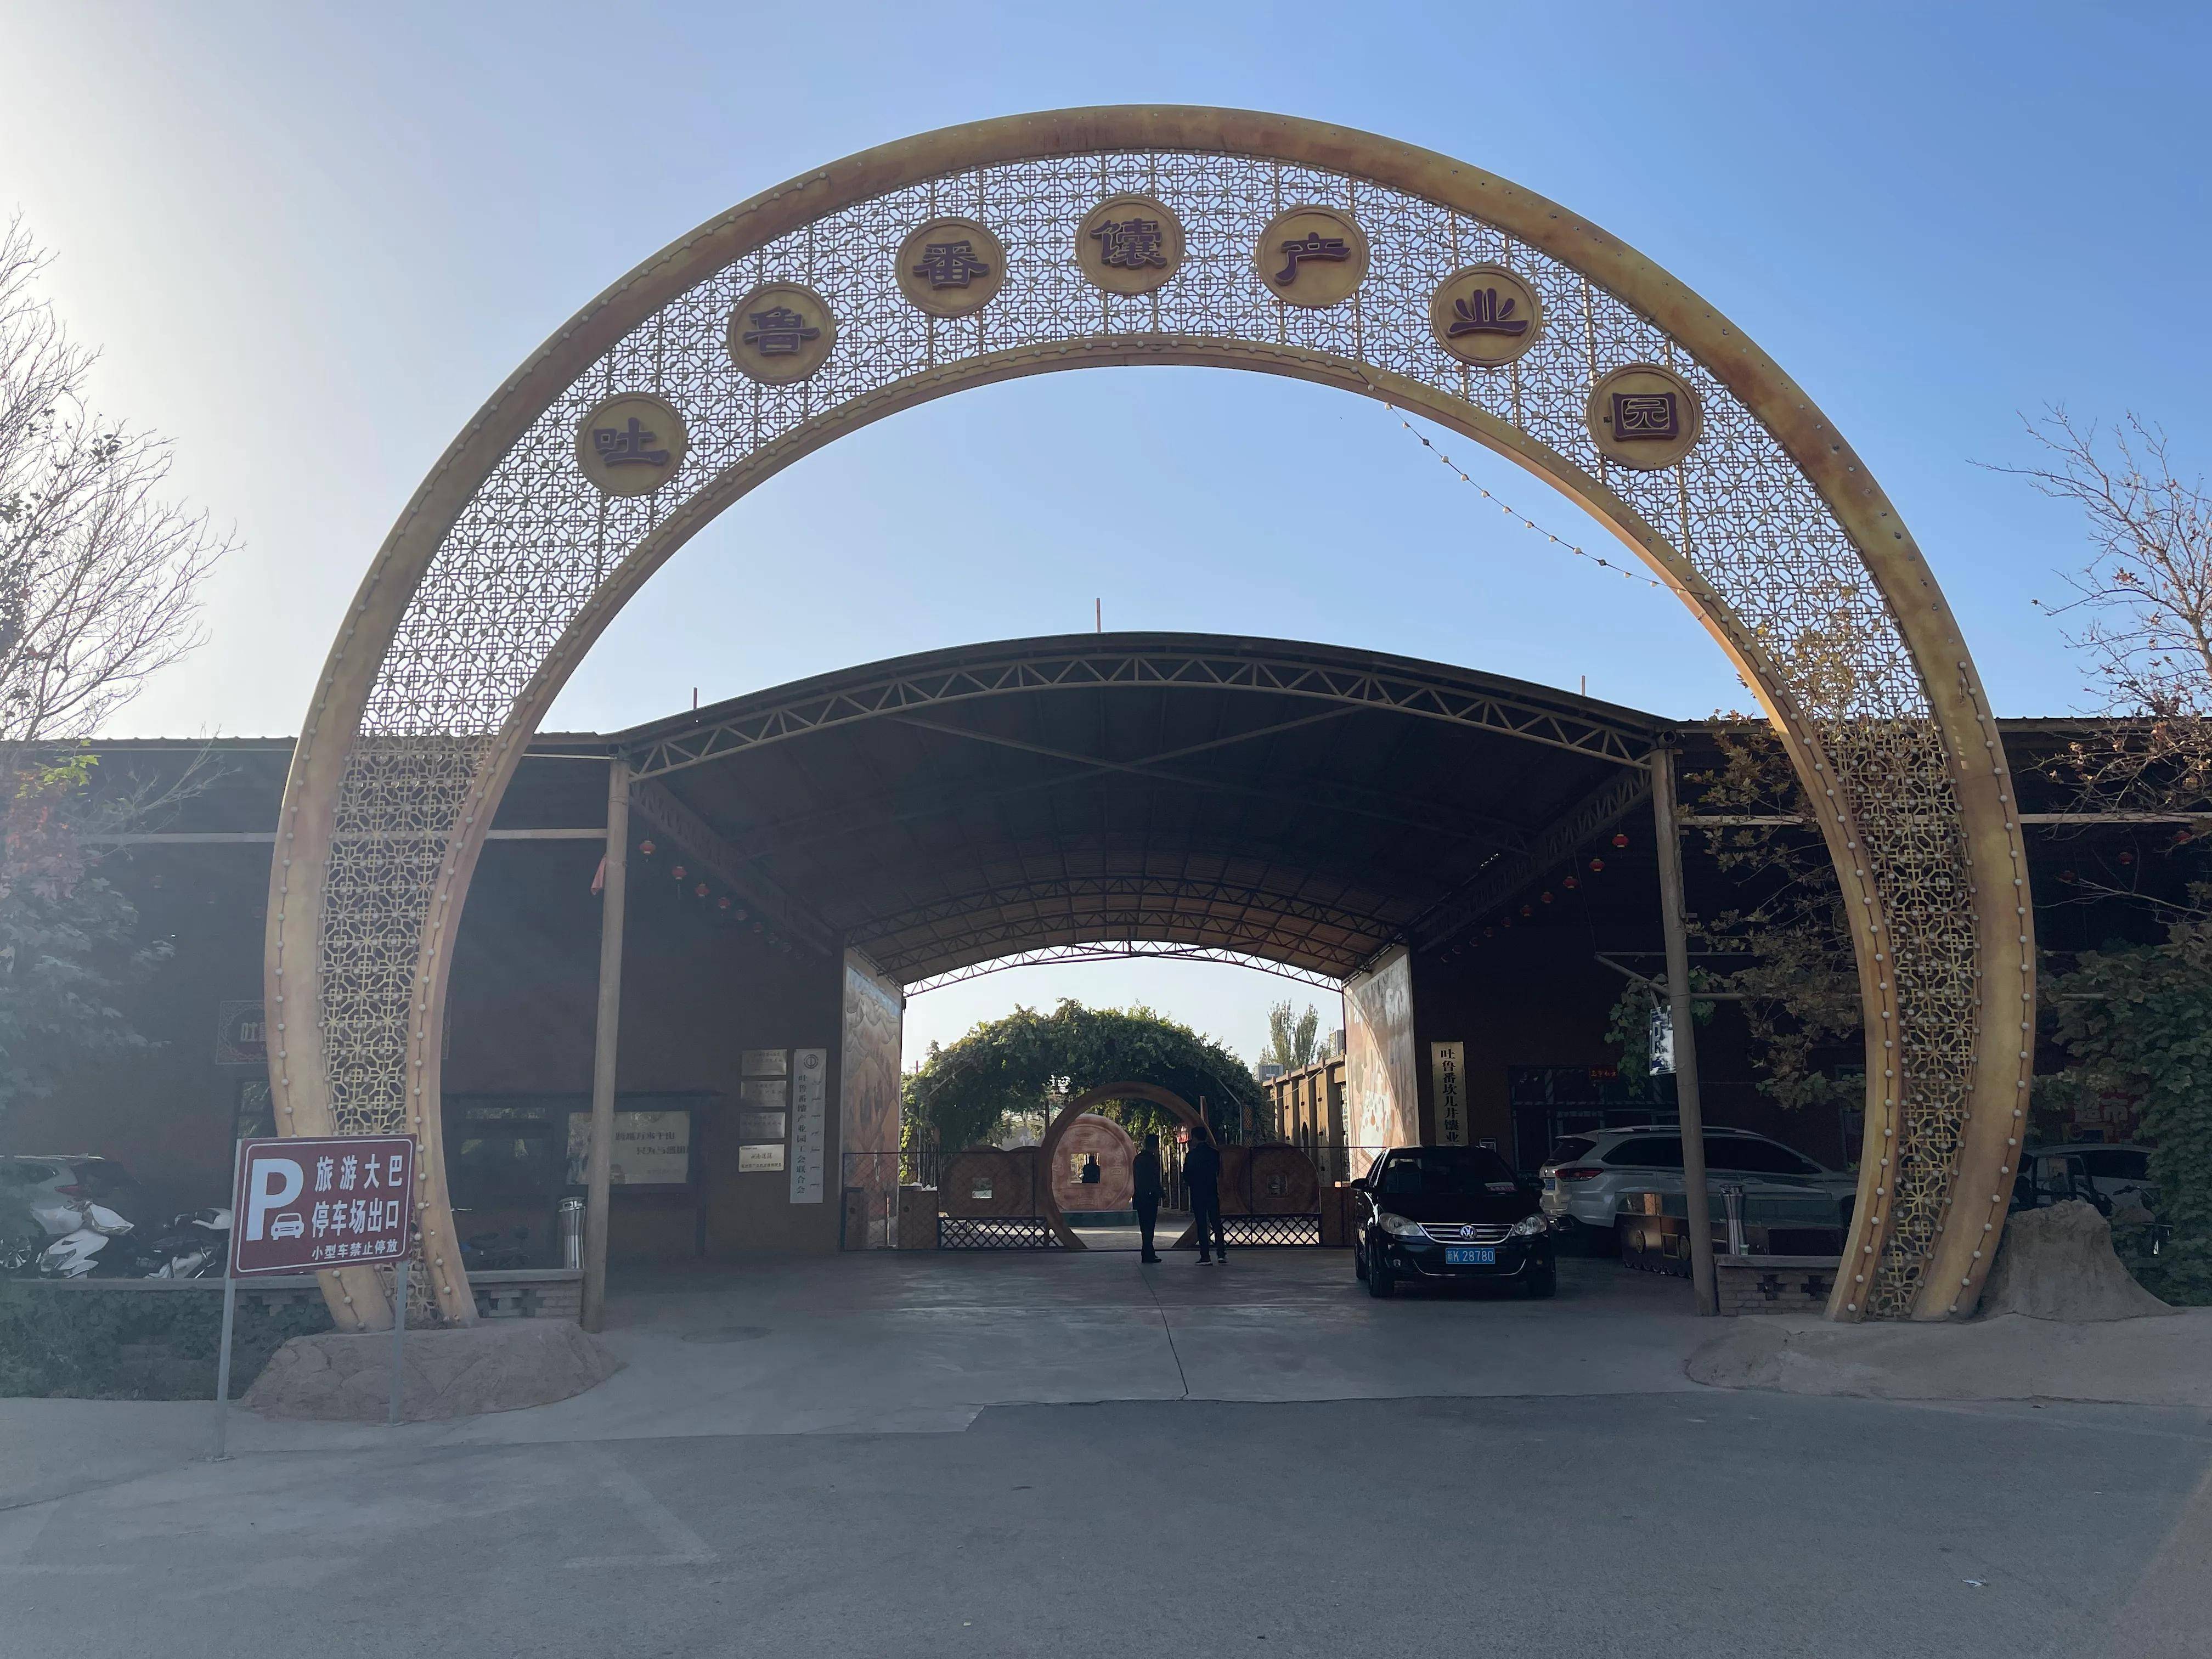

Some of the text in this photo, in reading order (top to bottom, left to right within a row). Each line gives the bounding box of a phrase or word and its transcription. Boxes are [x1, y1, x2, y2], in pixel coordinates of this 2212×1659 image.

[593, 217, 1678, 467] 吐鲁番馕产业园
[314, 1154, 403, 1192] 旅游大巴
[246, 1158, 304, 1242] P
[312, 1198, 399, 1238] 停车场出口
[312, 1239, 398, 1261] 小型车禁止停放
